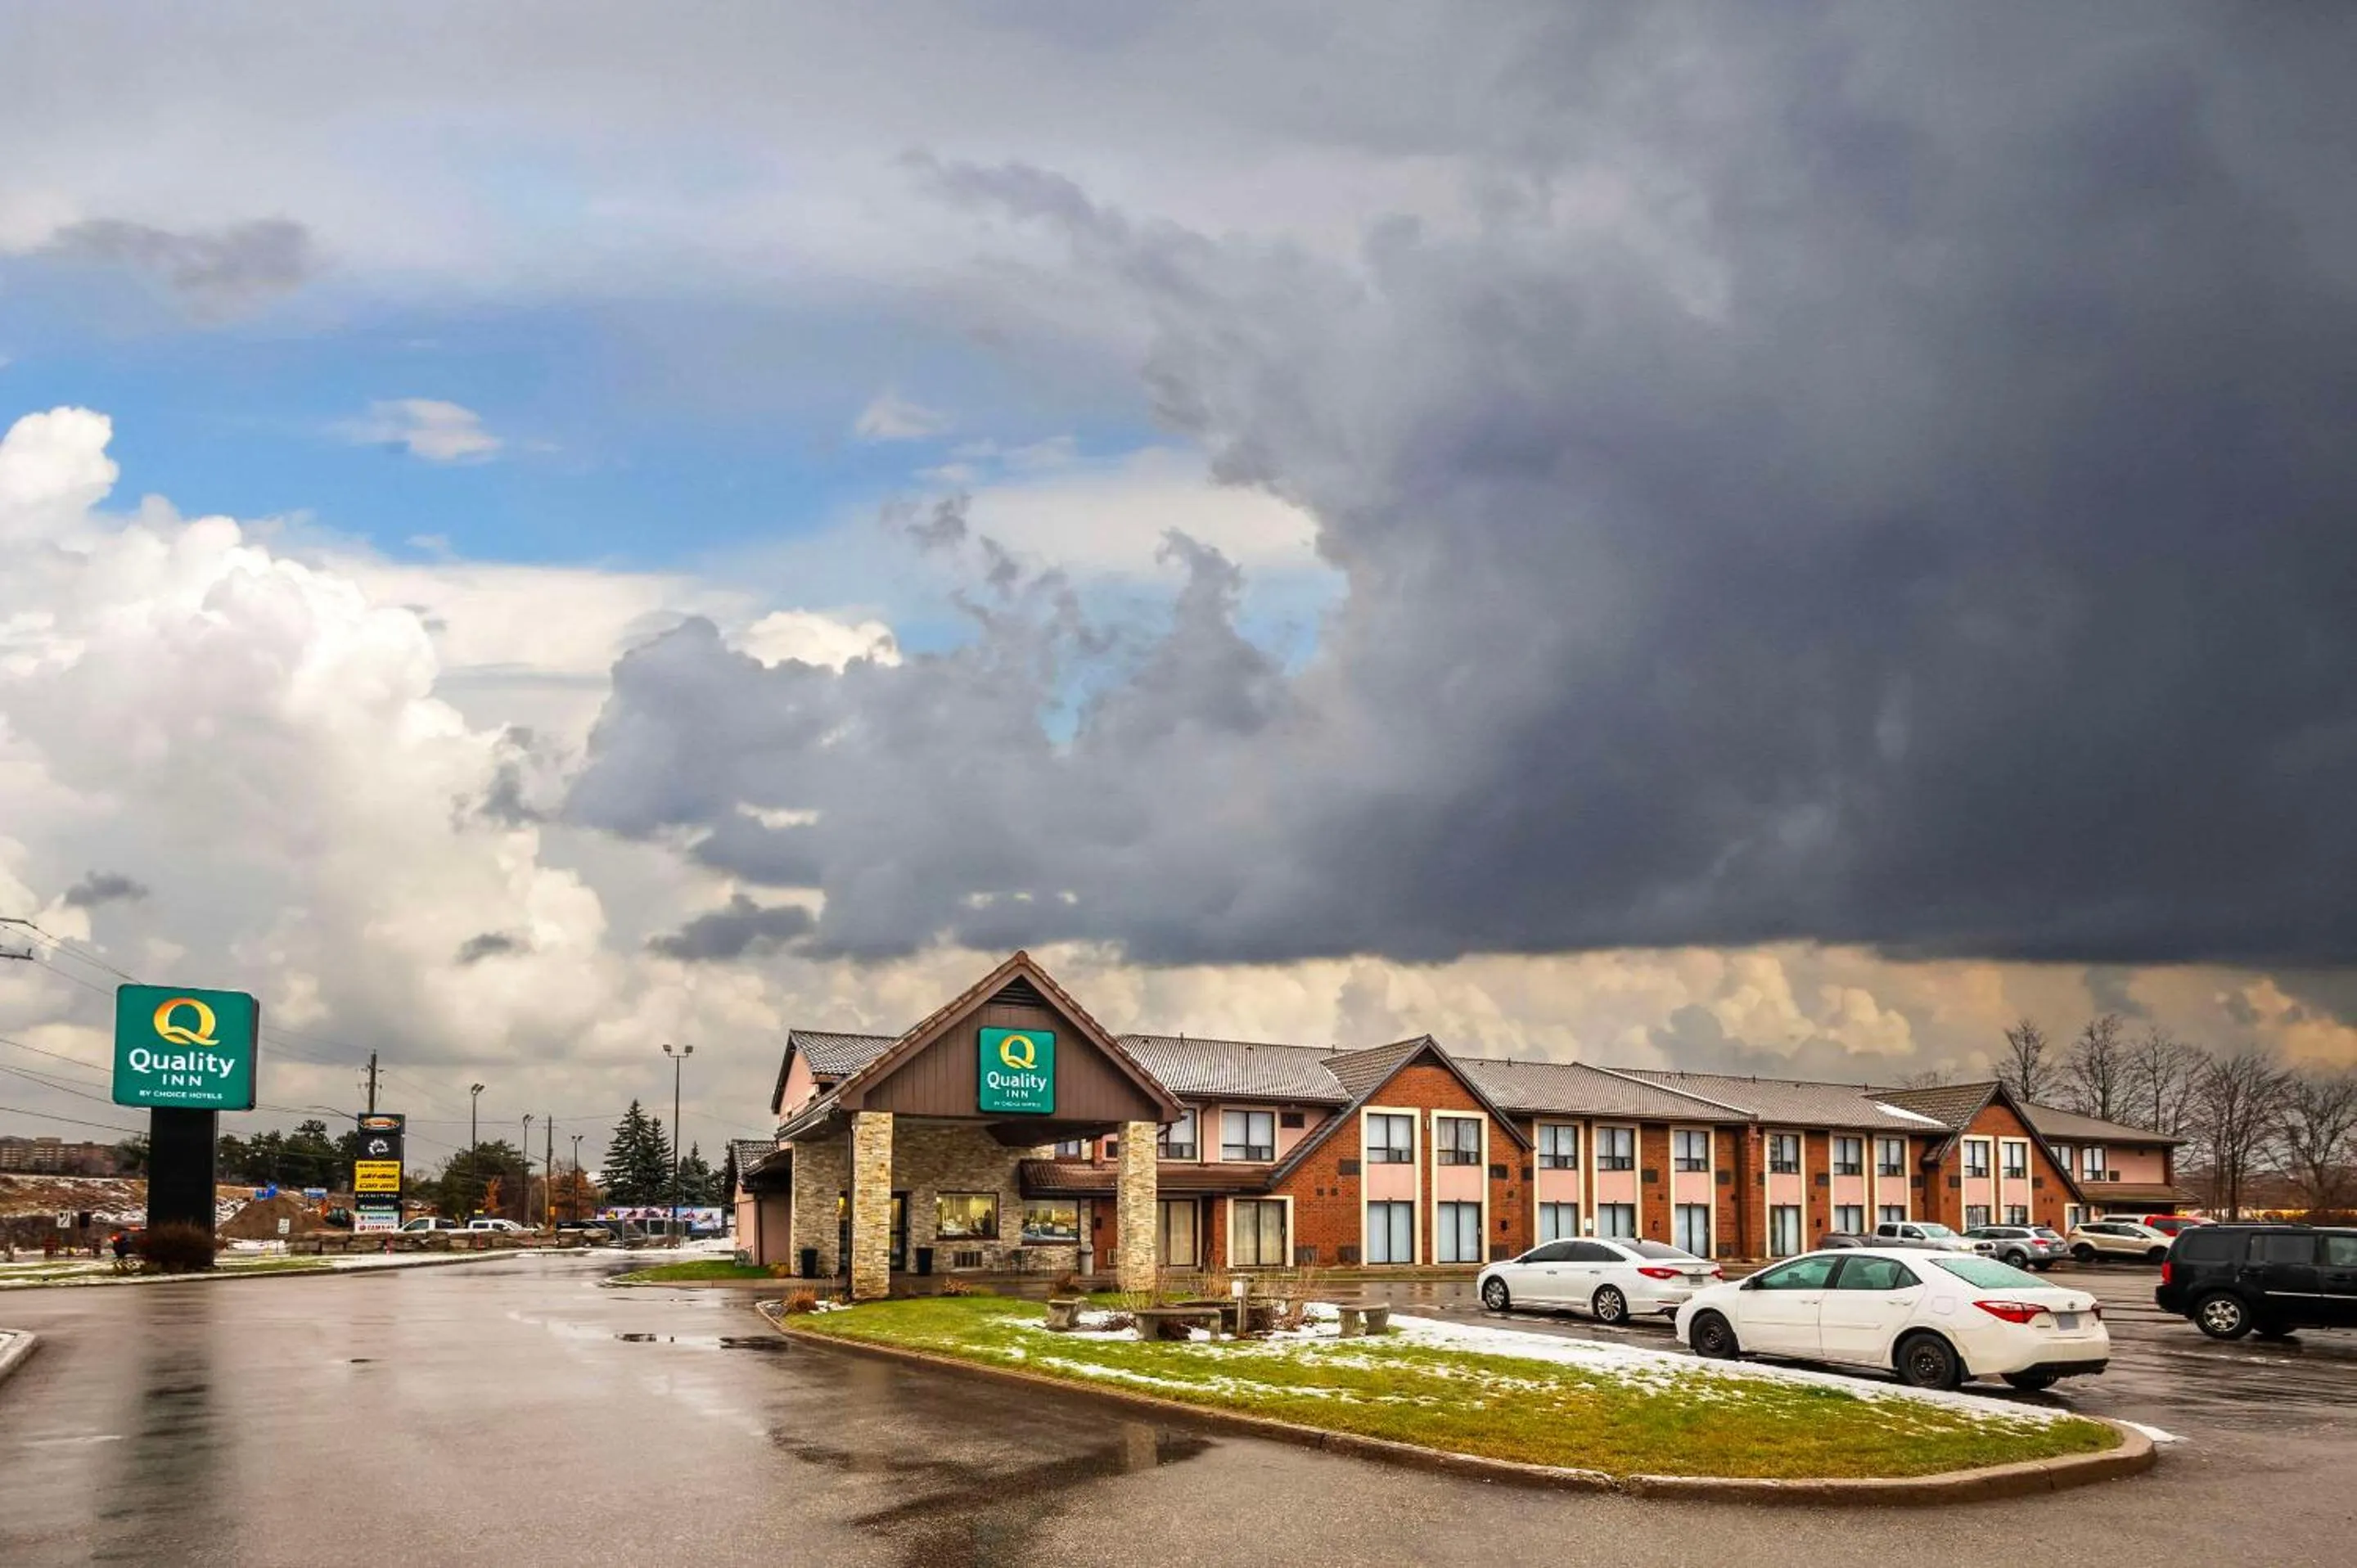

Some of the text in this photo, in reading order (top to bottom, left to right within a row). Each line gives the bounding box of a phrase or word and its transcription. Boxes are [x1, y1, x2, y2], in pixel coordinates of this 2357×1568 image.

[128, 1048, 235, 1079] Quality
[162, 1074, 202, 1086] INN
[987, 1070, 1047, 1093] Quality
[1006, 1089, 1029, 1098] INN
